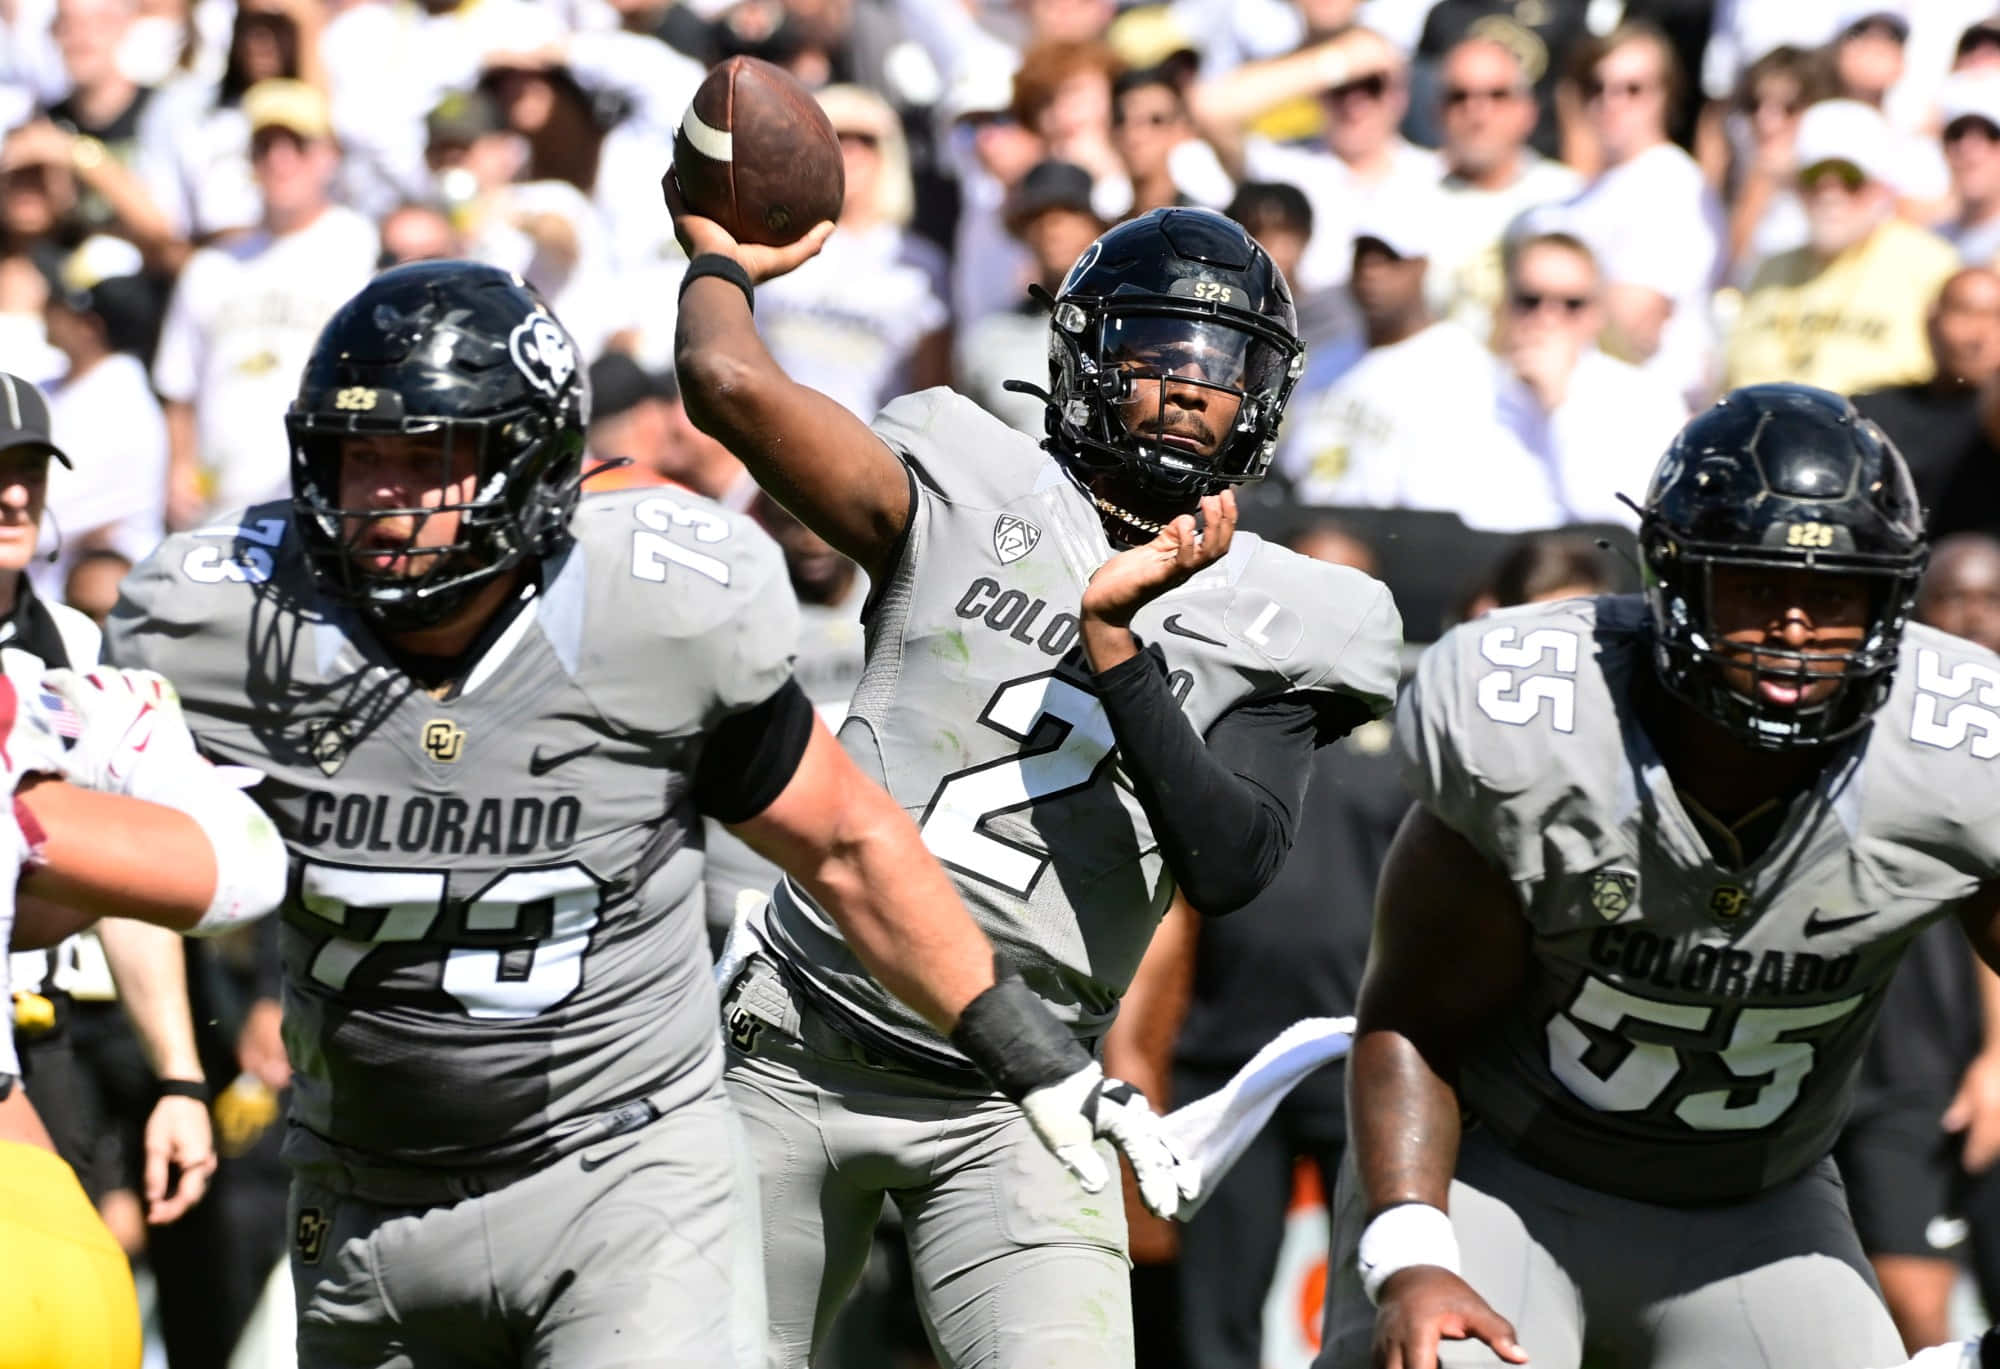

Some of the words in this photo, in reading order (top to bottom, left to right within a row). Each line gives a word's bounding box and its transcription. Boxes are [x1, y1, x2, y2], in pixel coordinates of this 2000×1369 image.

[631, 497, 731, 587] 73
[1243, 600, 1281, 646] L
[1477, 625, 1578, 735] 55
[1908, 647, 2000, 760] 55
[303, 790, 583, 856] COLORADO
[919, 669, 1117, 900] 2
[300, 859, 610, 1022] 73
[1589, 922, 1861, 999] COLORADO
[1544, 972, 1870, 1132] 55
